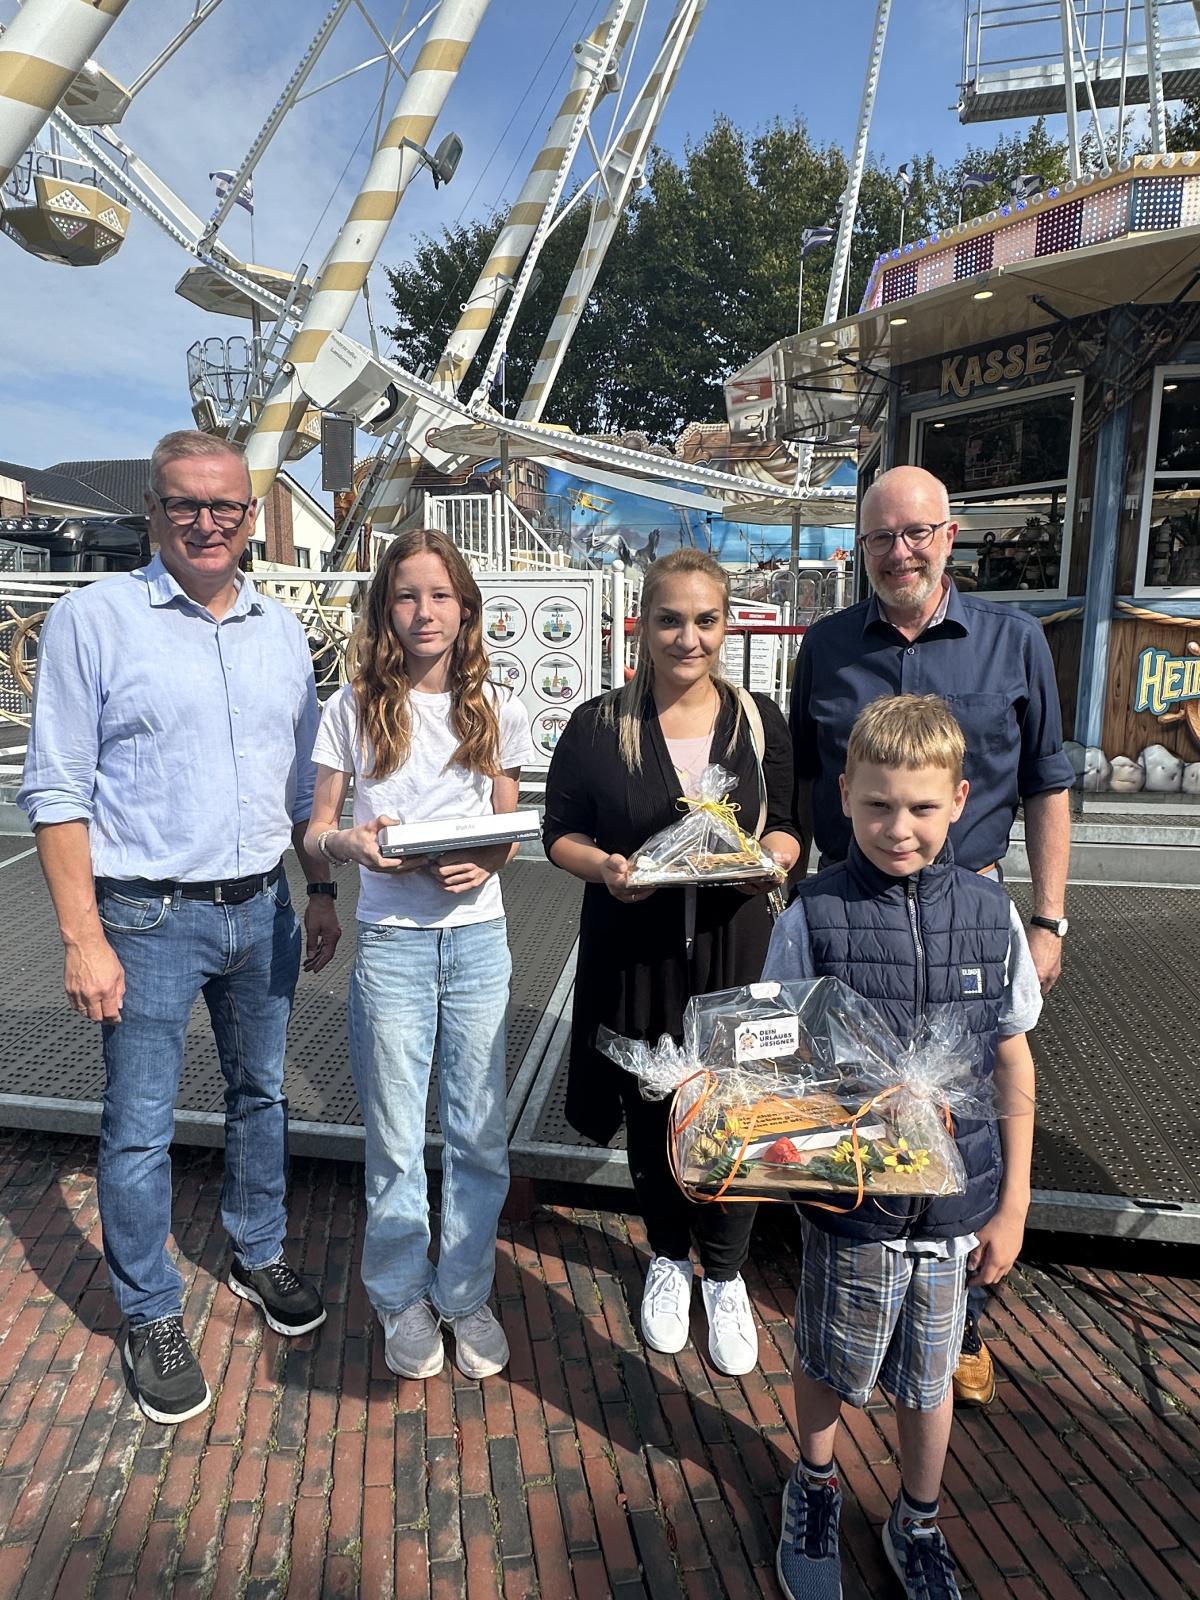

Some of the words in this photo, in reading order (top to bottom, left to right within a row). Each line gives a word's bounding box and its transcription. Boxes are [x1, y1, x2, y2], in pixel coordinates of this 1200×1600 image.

[940, 331, 1053, 398] KASSE
[759, 1033, 792, 1041] URLAUBS
[759, 1038, 794, 1047] DESIGNER
